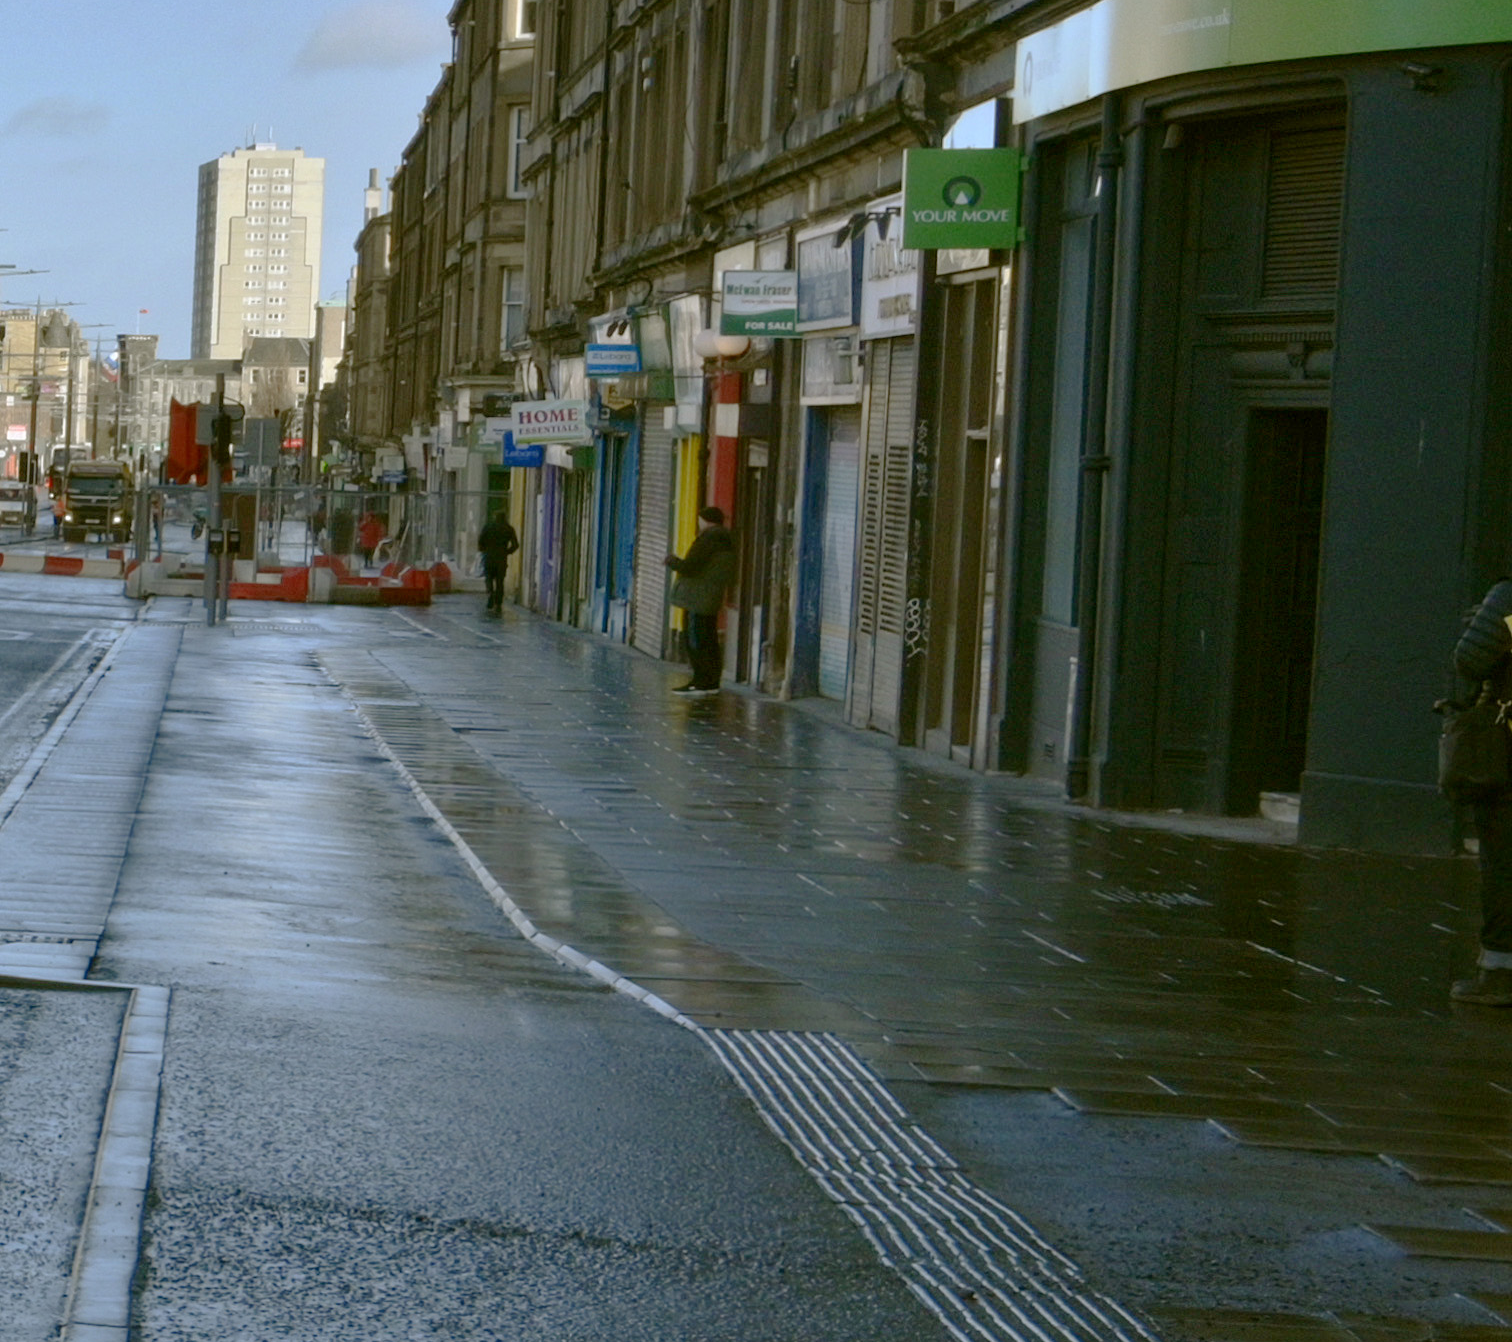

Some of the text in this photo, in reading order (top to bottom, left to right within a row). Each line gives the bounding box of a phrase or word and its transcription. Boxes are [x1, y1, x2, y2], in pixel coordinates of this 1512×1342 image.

[913, 210, 1009, 222] YOUR MOVE
[726, 284, 792, 296] McEwan Fraser
[745, 322, 793, 330] FOR SALE
[519, 408, 578, 425] HOME
[519, 424, 579, 435] ESSENTIALS
